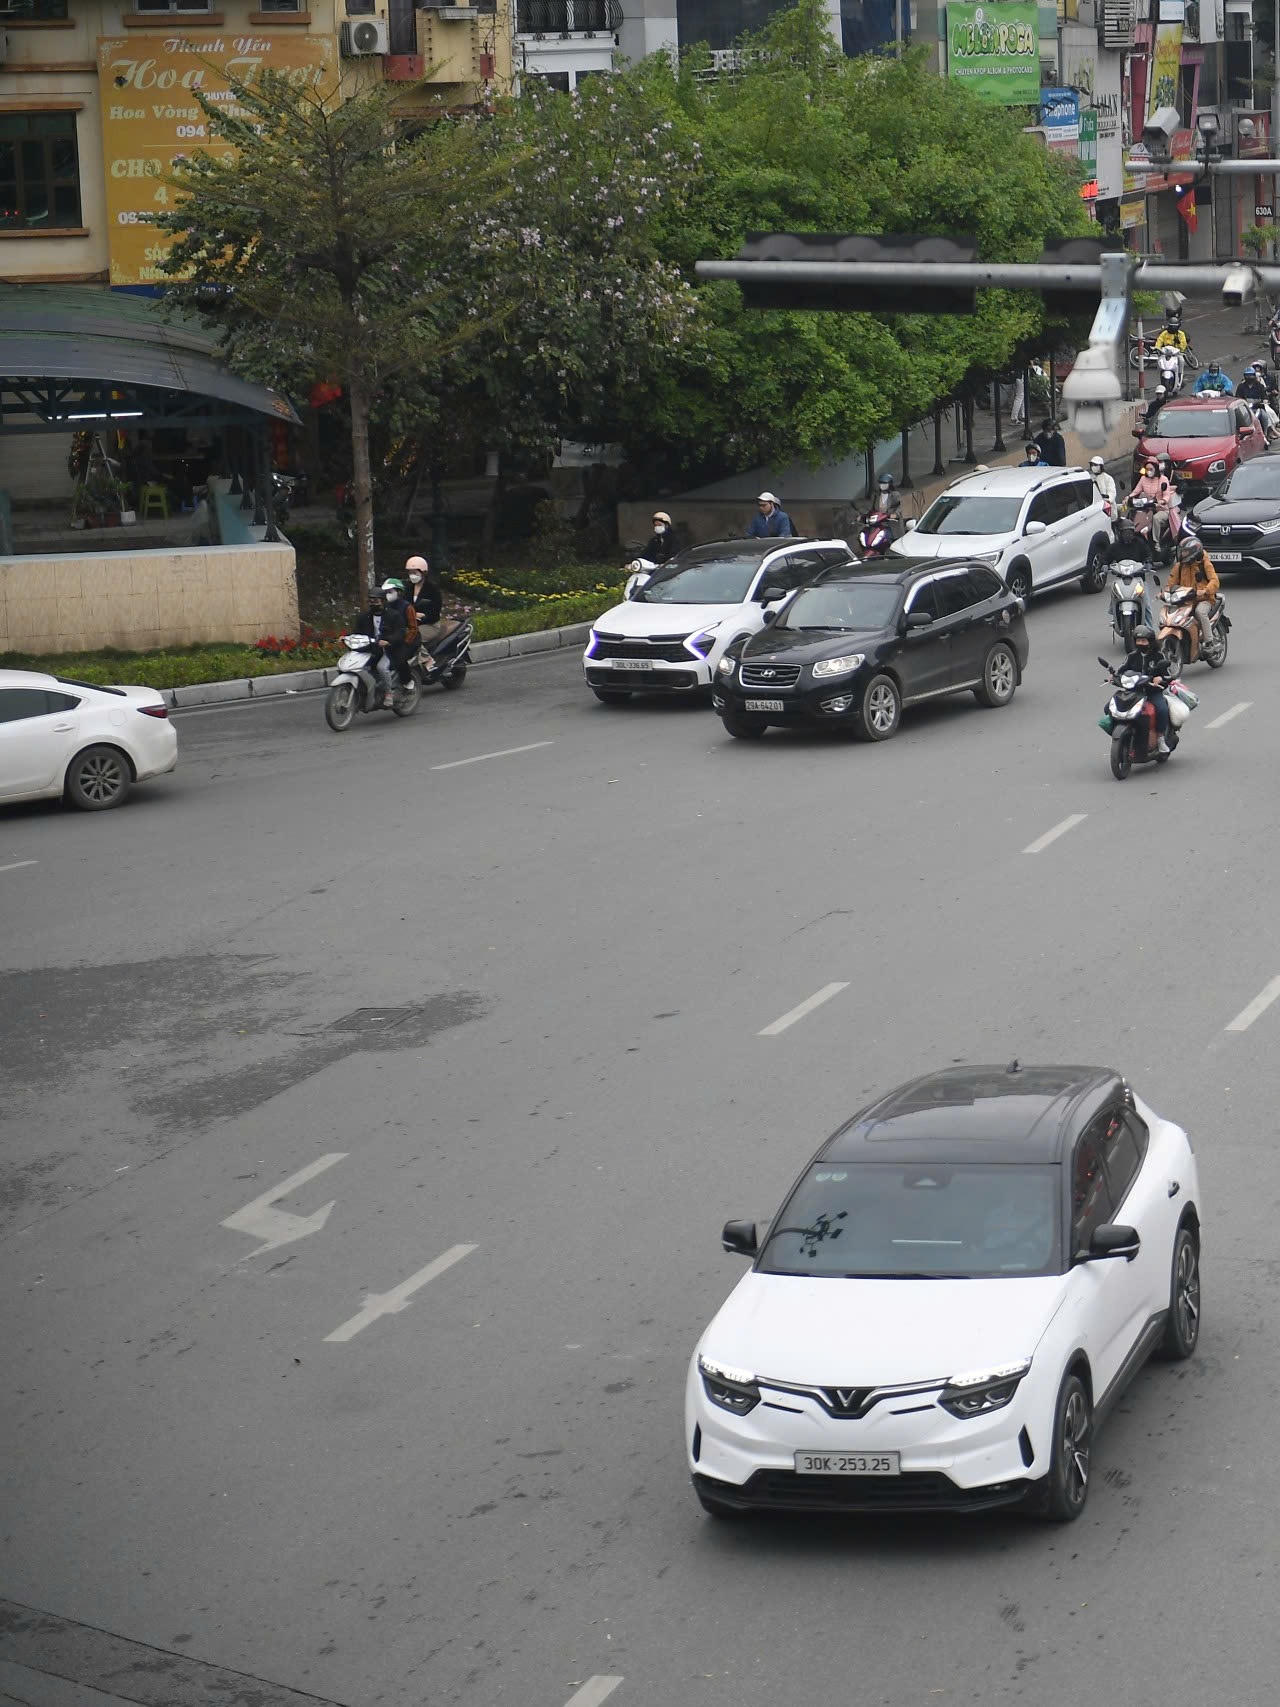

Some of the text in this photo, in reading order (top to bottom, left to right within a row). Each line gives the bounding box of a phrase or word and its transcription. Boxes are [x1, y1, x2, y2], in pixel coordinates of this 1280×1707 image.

[110, 58, 208, 90] Hoa
[1255, 206, 1272, 216] 630A
[804, 1457, 890, 1471] 30K-253.25
